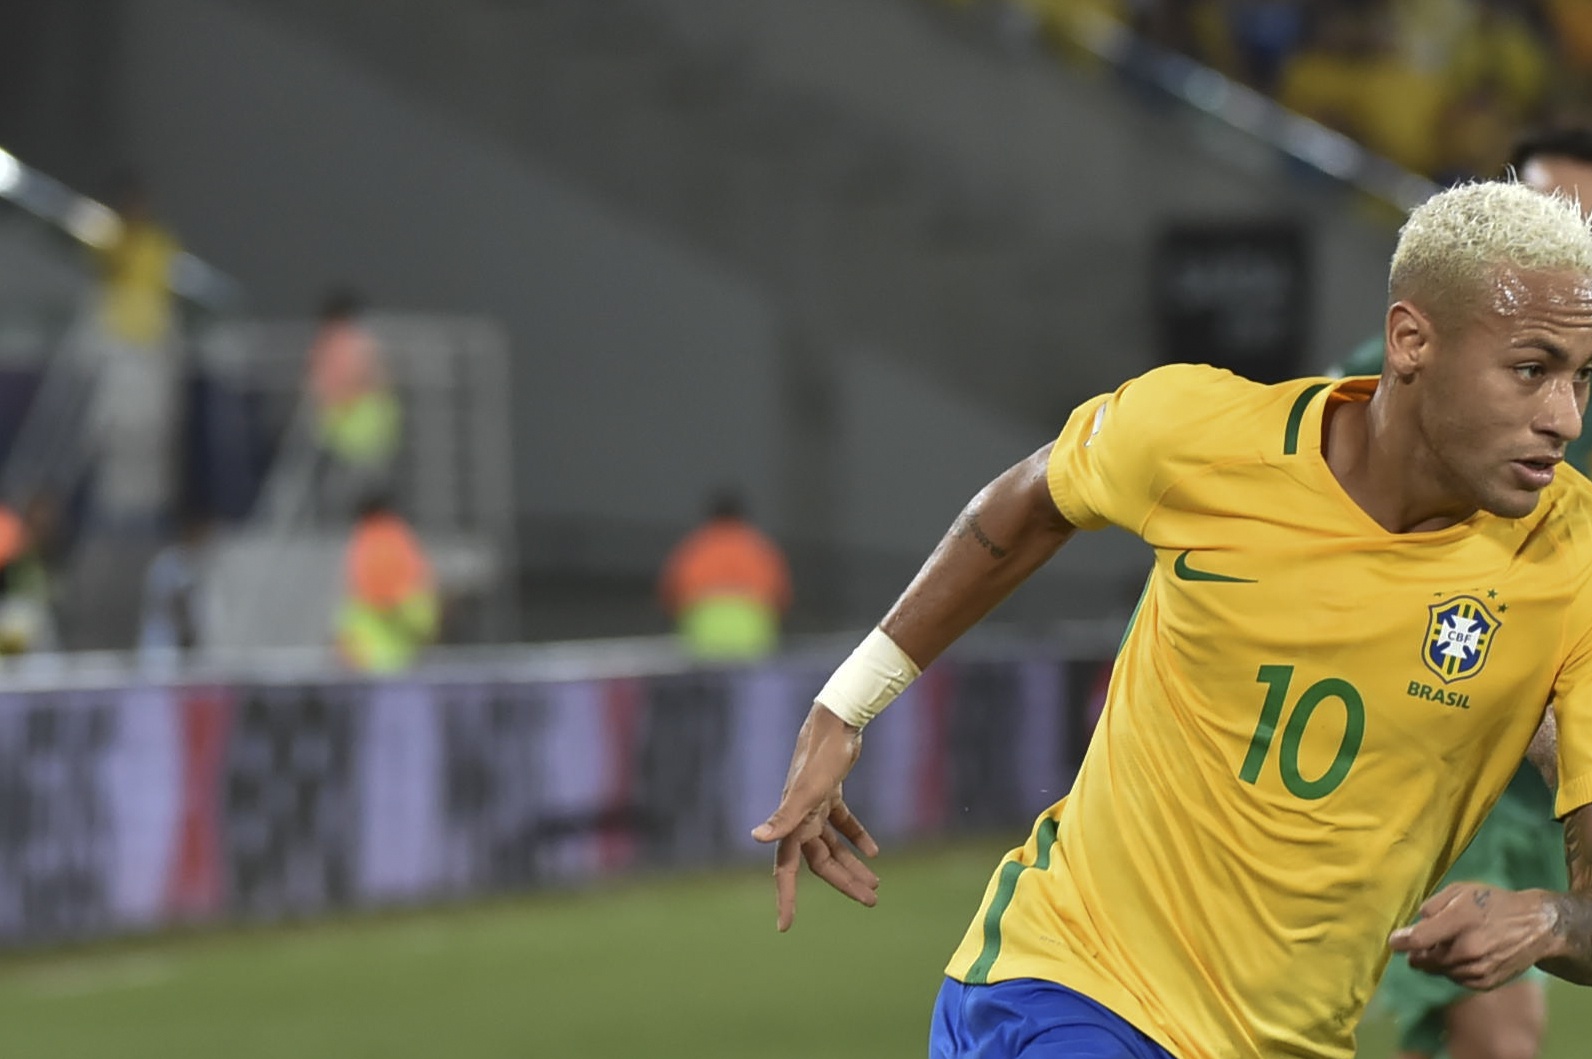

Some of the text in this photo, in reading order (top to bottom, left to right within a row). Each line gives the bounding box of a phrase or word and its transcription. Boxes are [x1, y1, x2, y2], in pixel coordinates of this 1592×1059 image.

[1447, 631, 1472, 644] CBF
[1407, 680, 1471, 709] BRASIL
[1238, 664, 1366, 801] 10
